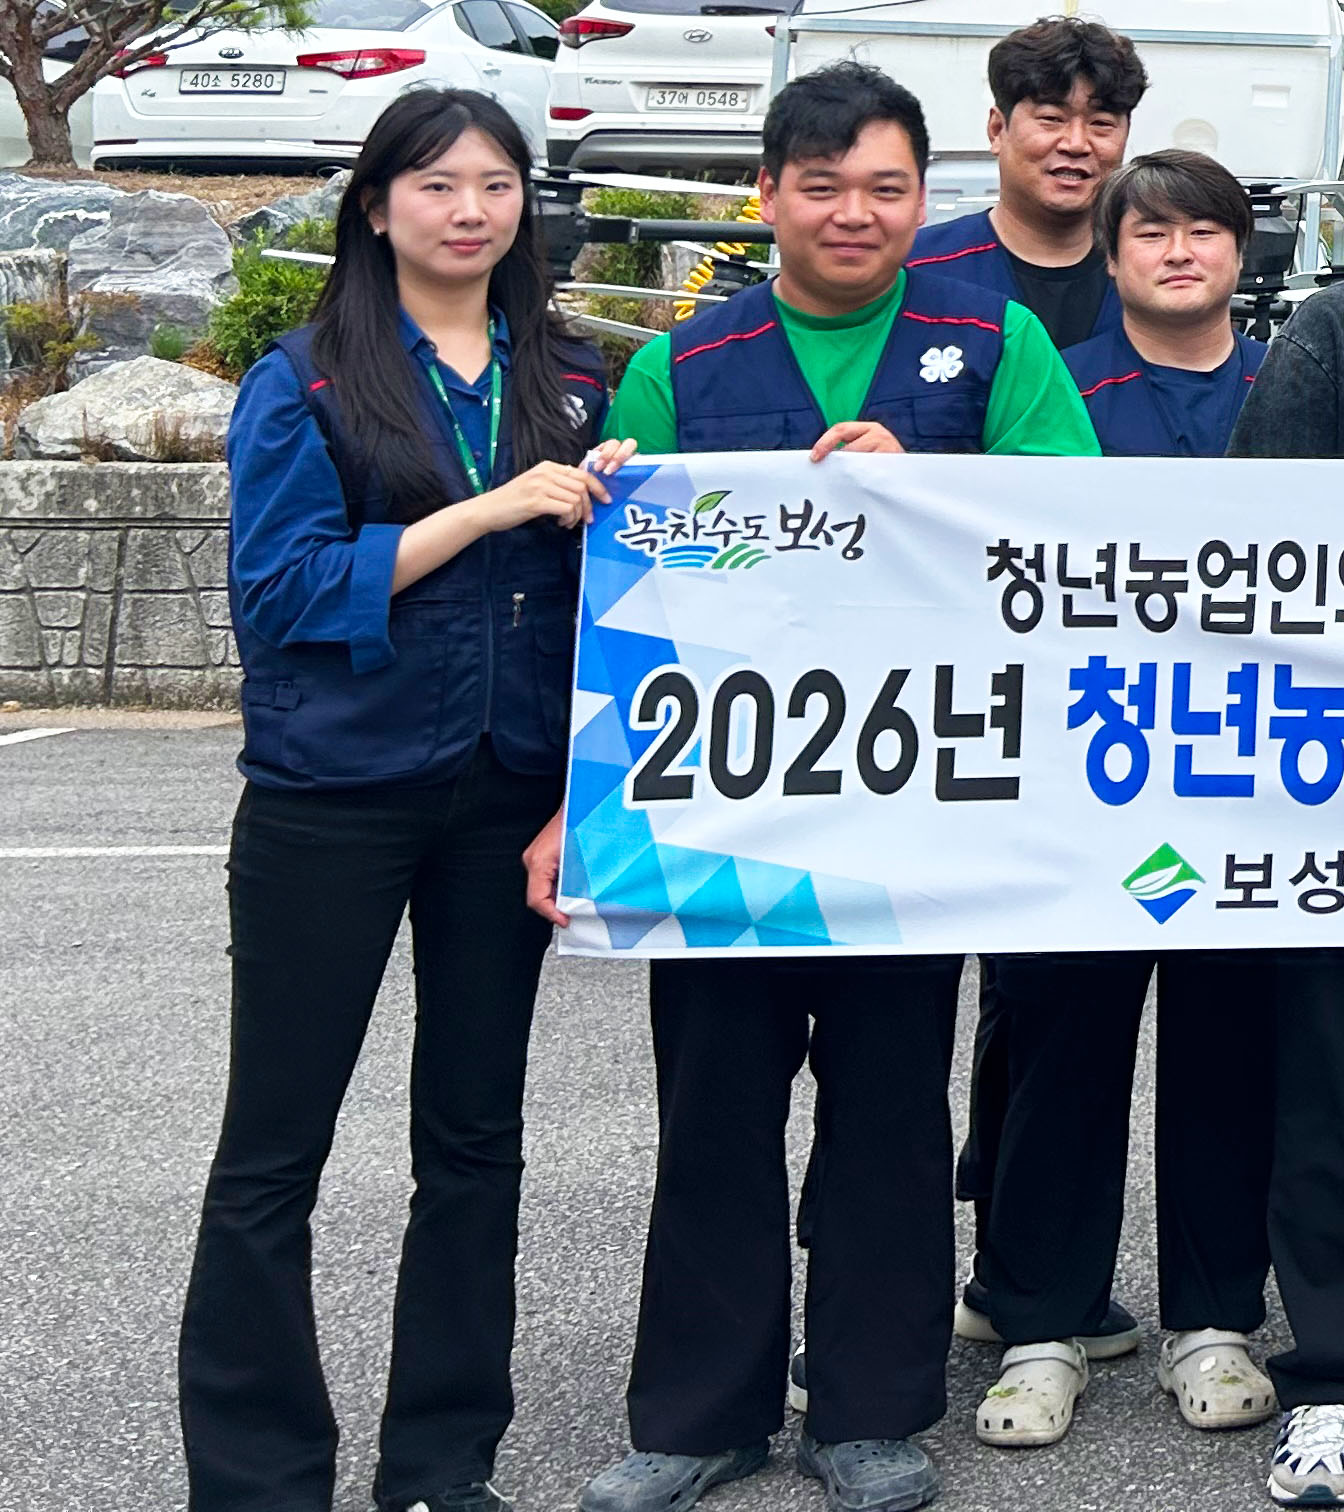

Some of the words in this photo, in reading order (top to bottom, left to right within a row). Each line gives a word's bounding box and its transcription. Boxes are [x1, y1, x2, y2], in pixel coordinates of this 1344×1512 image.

[230, 72, 275, 88] 5280
[695, 91, 740, 108] 0548
[619, 507, 771, 553] 녹차수도
[775, 498, 867, 562] 보성
[632, 663, 1026, 803] 2026년
